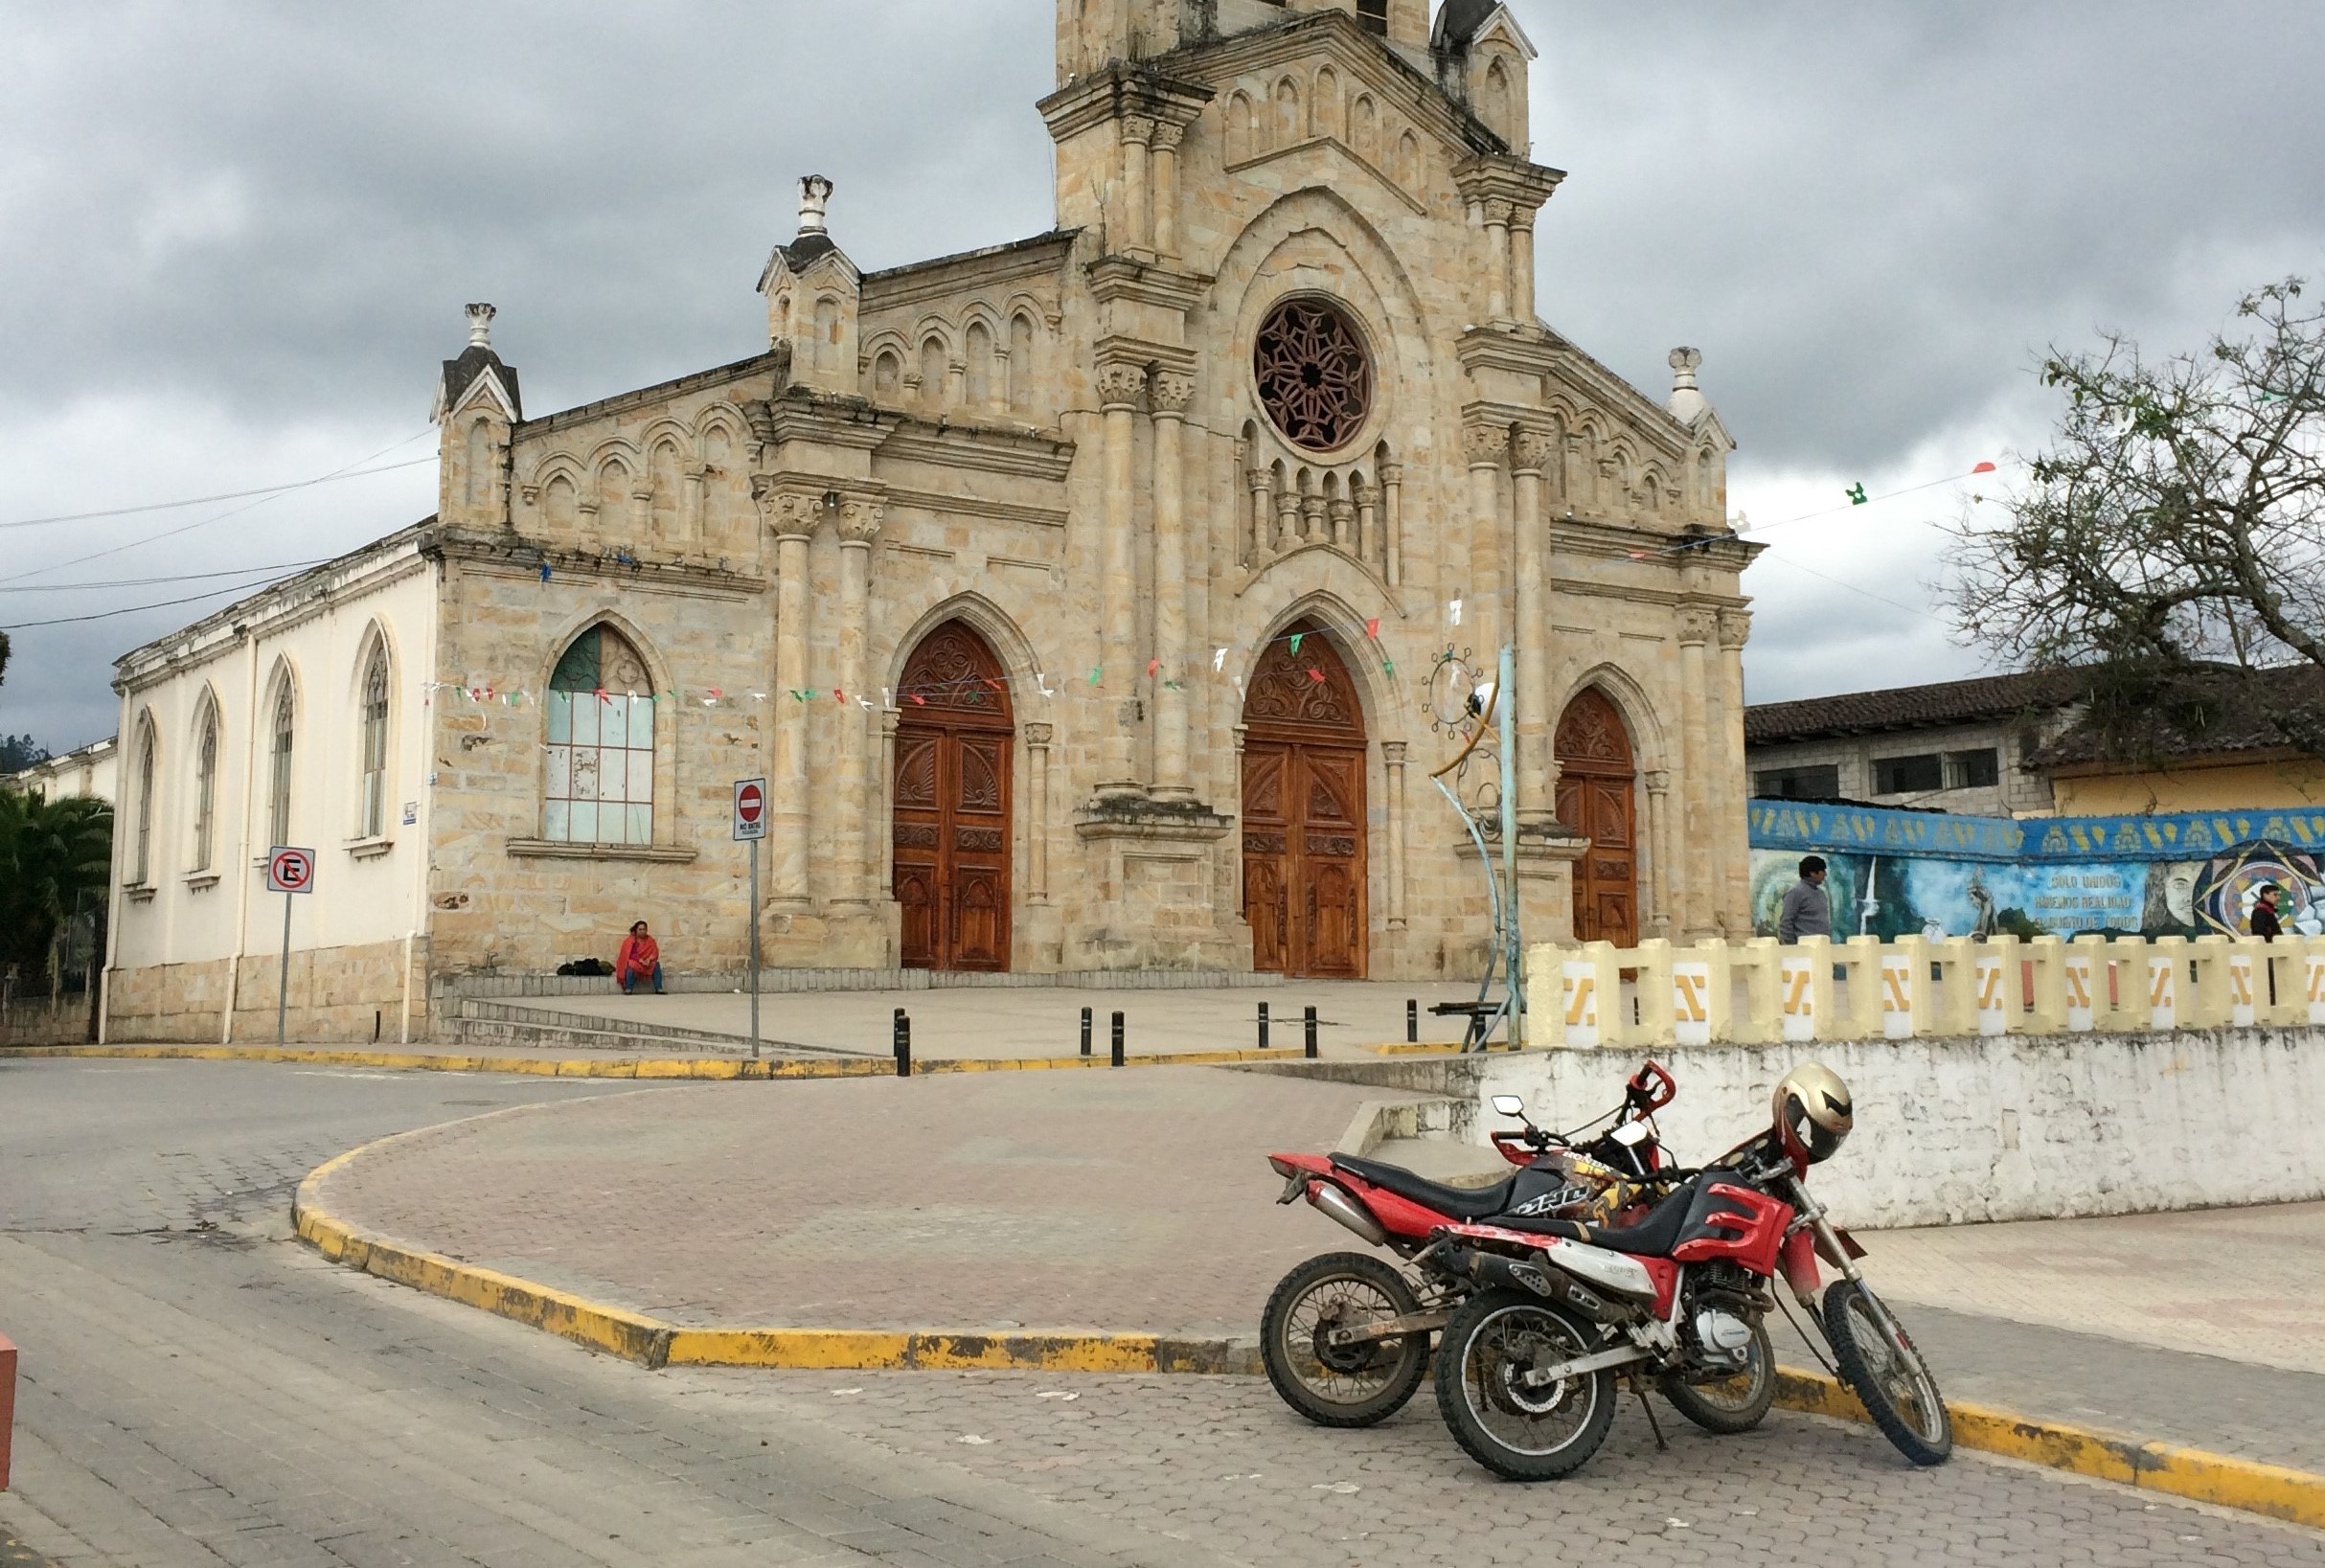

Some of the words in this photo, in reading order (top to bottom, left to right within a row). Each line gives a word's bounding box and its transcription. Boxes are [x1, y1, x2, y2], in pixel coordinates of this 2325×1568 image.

[283, 858, 301, 881] E
[2051, 875, 2077, 888] SOLO
[2082, 875, 2121, 888] UNIDOS
[2082, 897, 2131, 909] REALIDAD
[2086, 916, 2100, 929] DE
[1562, 1150, 1613, 1172] HONDA
